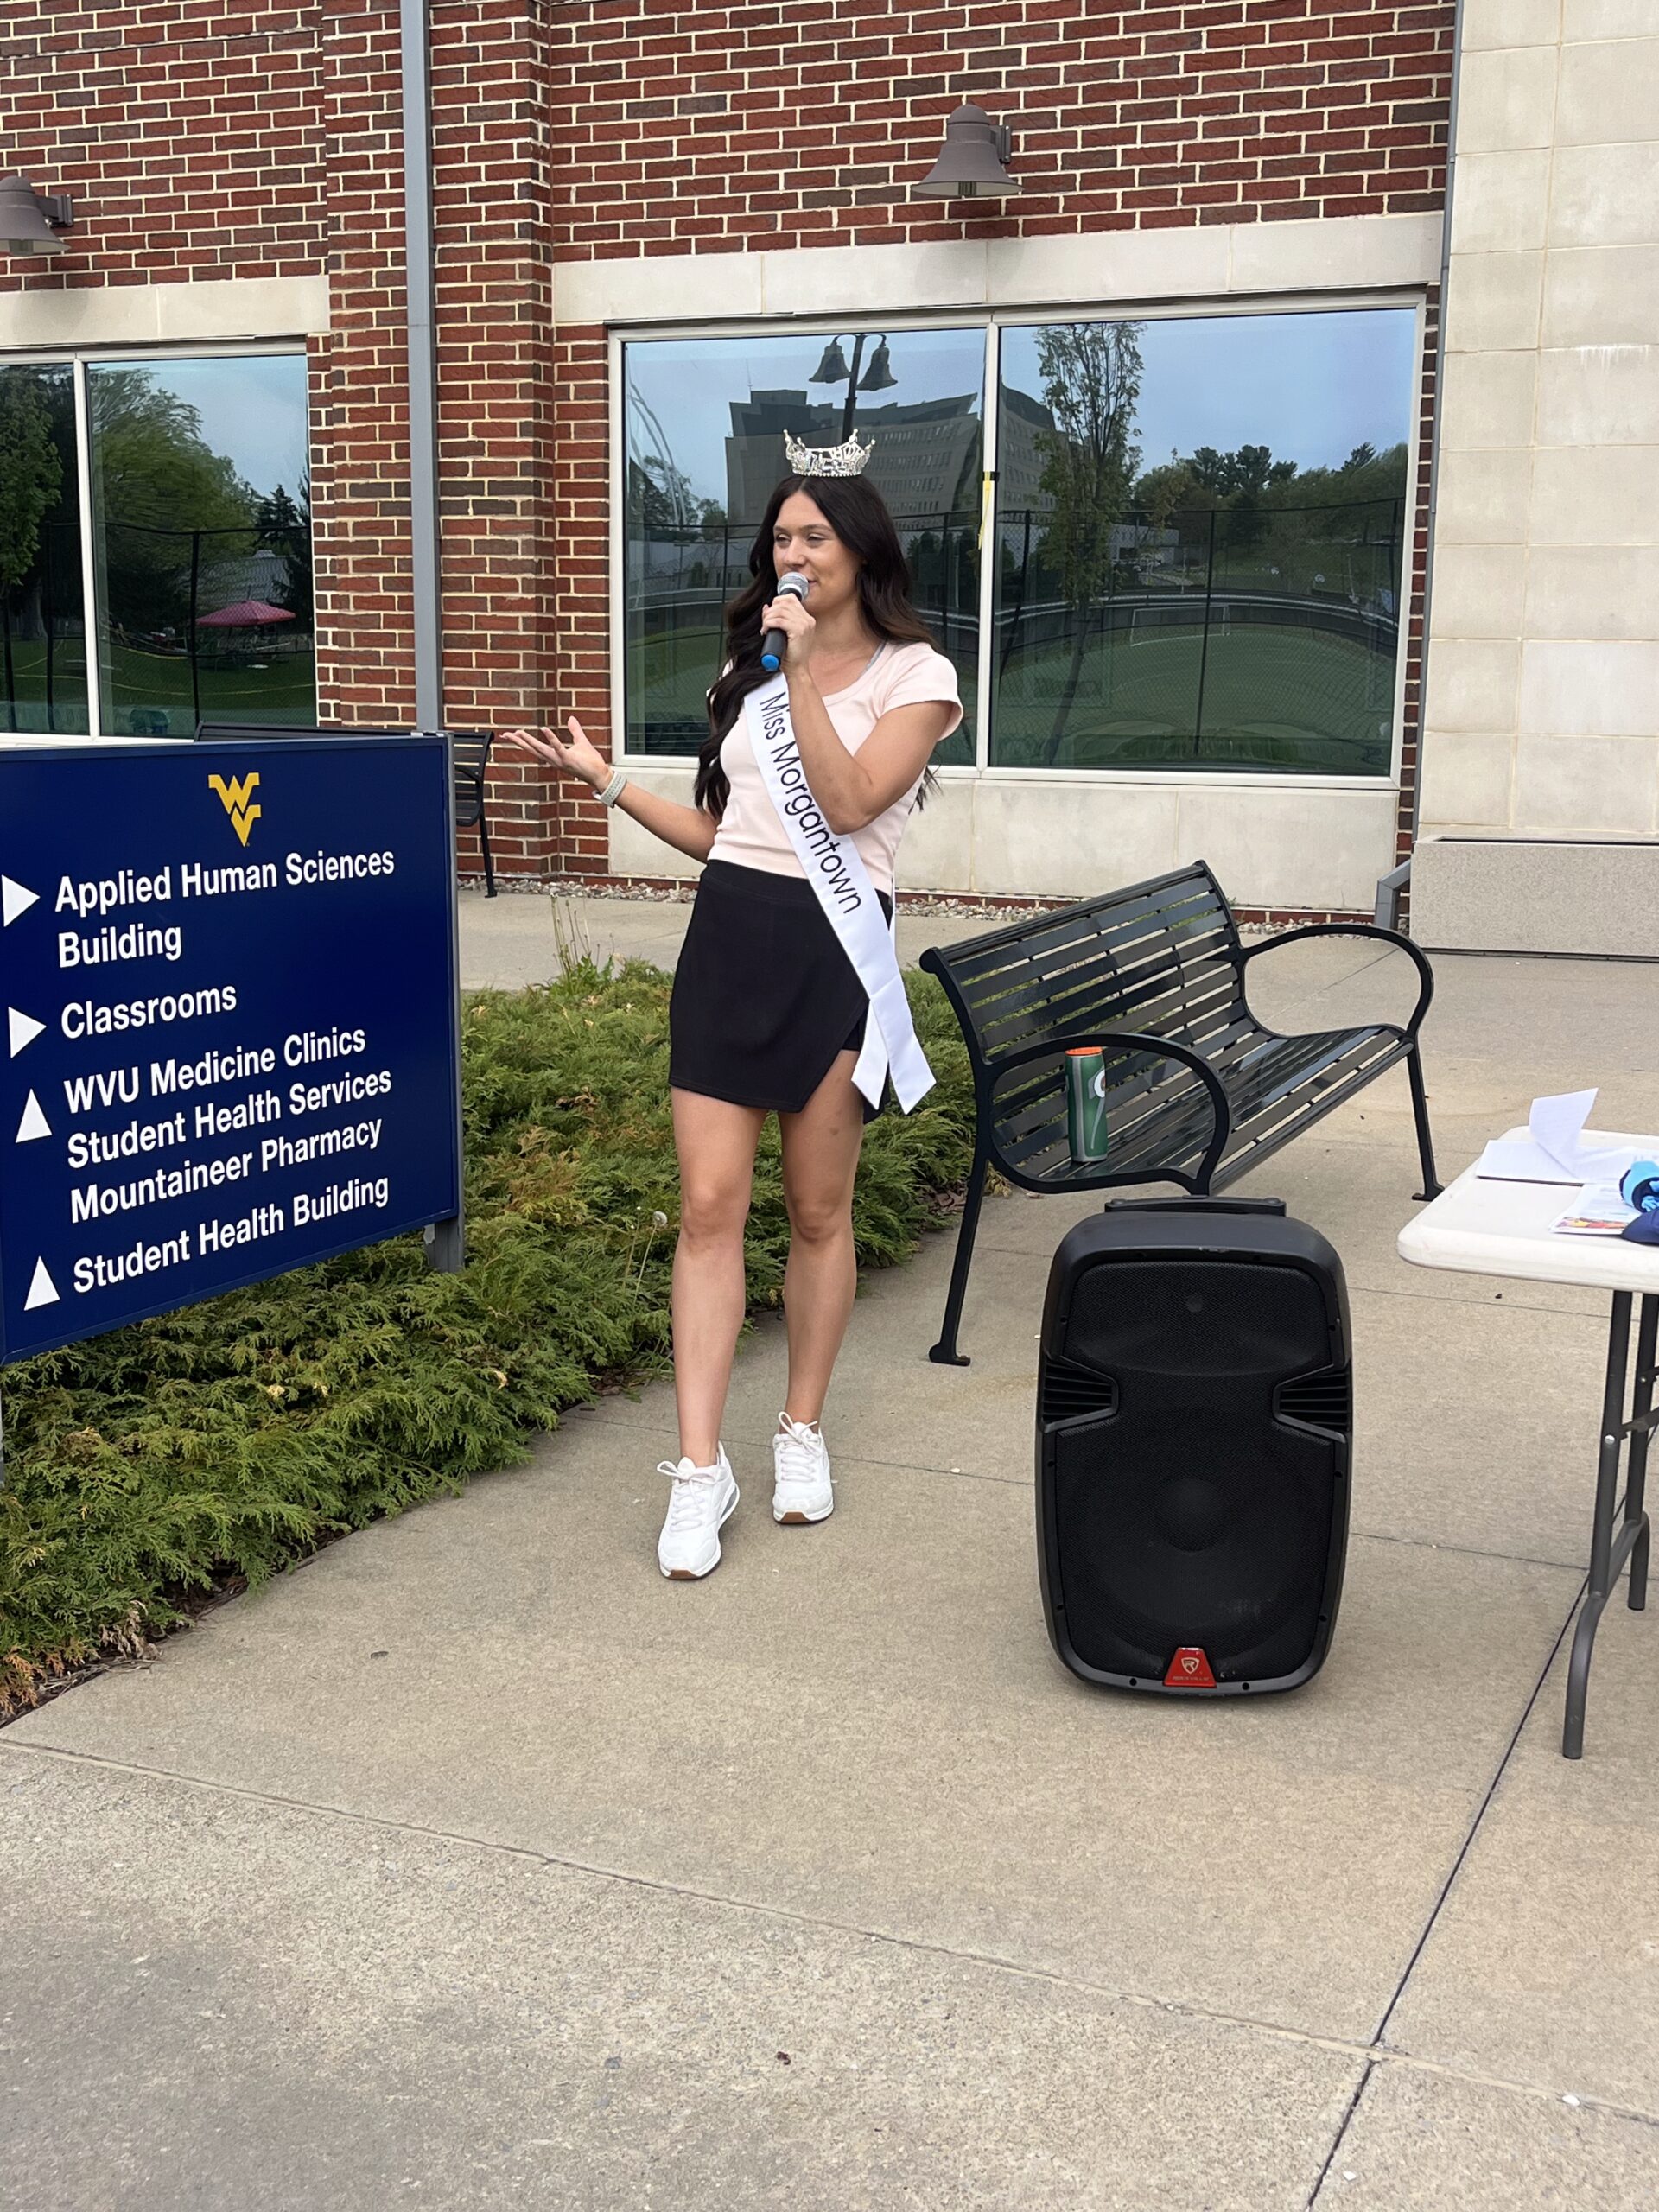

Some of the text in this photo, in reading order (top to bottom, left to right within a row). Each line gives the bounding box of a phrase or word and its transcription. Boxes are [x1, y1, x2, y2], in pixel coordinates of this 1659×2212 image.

[760, 691, 861, 914] Miss Morgantown
[54, 849, 395, 917] Applied Human Sciences
[58, 923, 182, 968] Building
[60, 985, 237, 1039] Classrooms
[63, 1027, 365, 1114] WVU Medicine Clinics
[67, 1069, 392, 1168] Student Health Services
[70, 1119, 383, 1223] Mountaineer Pharmacy
[73, 1177, 390, 1293] Student Health Building
